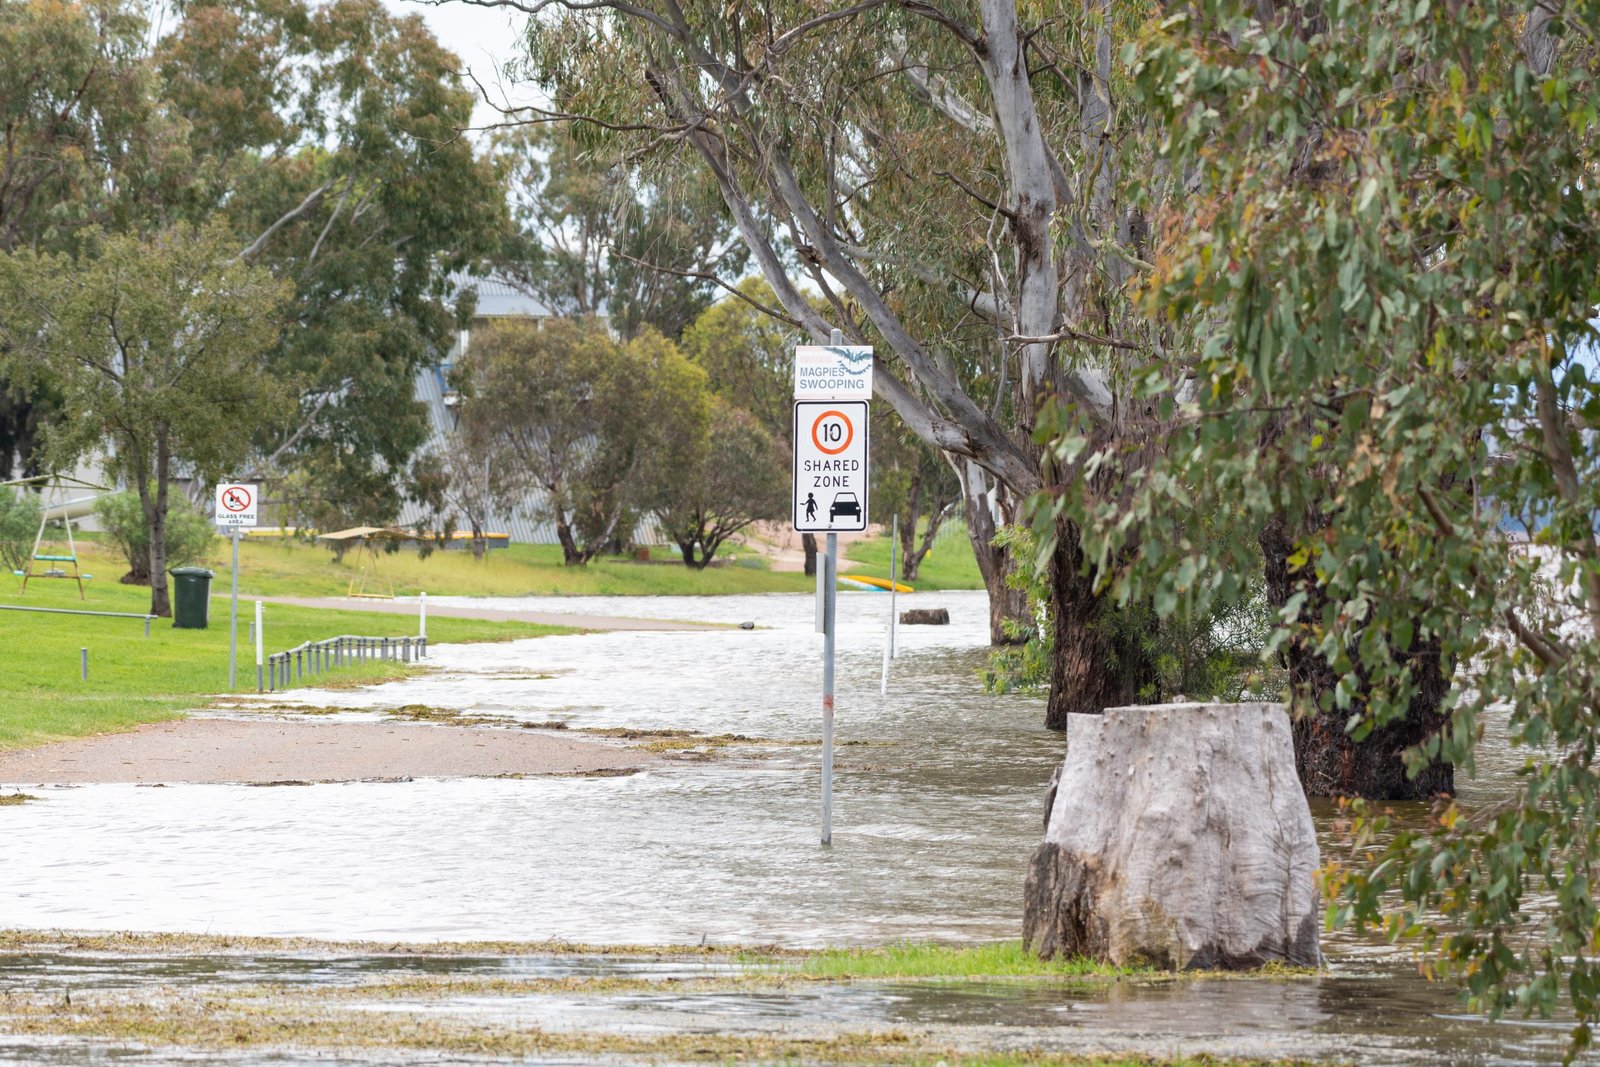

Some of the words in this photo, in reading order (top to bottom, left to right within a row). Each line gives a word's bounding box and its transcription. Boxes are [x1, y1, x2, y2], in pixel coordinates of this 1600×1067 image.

[800, 367, 845, 377] MAGPIES
[800, 379, 865, 389] SWOOPING
[823, 423, 842, 442] 10
[804, 460, 860, 472] SHARED
[813, 475, 850, 488] ZONE
